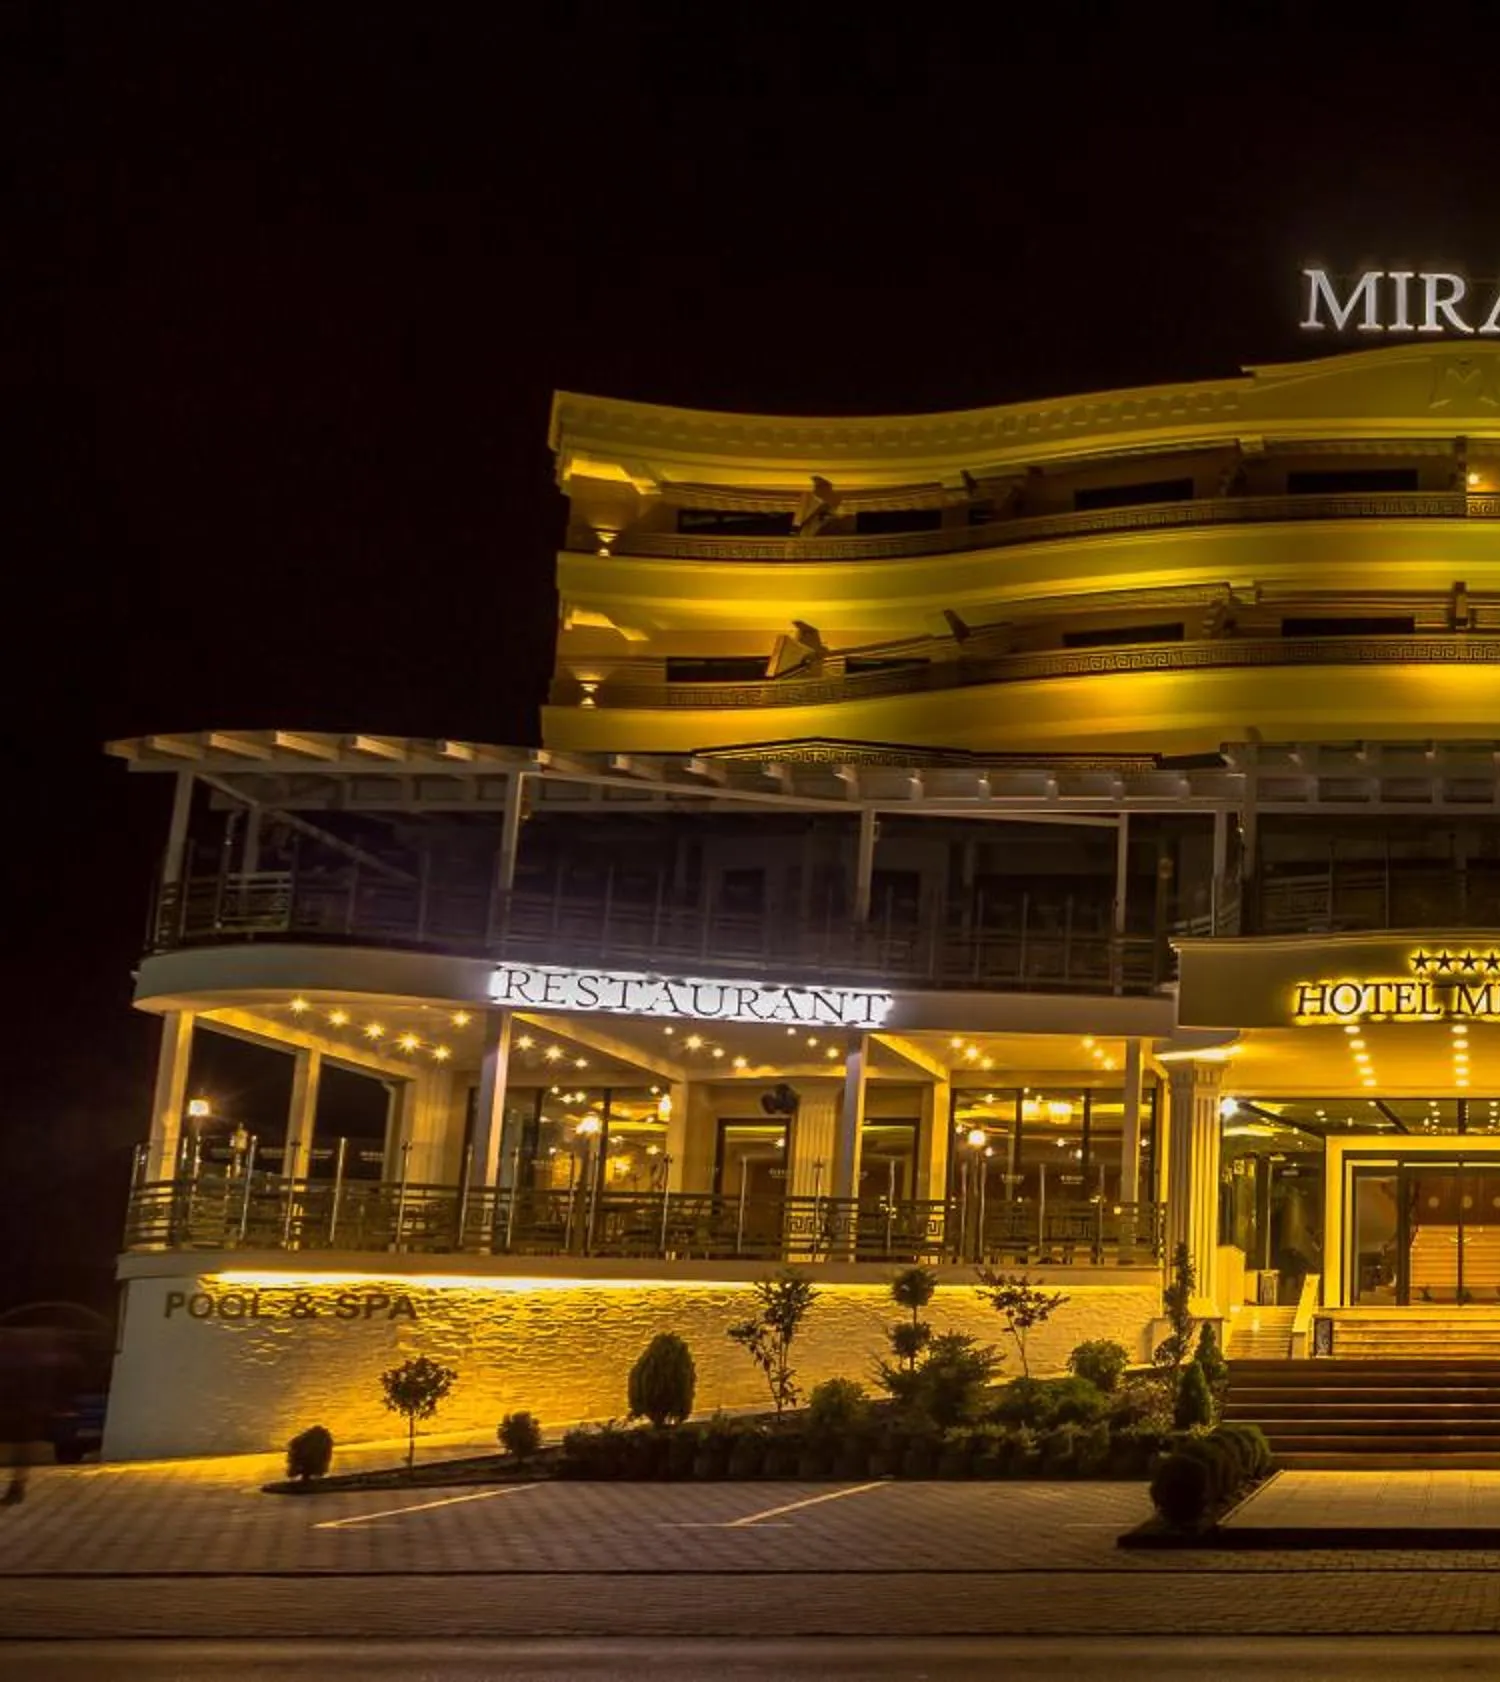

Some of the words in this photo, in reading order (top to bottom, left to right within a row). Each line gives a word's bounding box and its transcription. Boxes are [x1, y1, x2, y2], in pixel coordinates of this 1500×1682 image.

[497, 967, 893, 1026] RESTAURANT
[1296, 982, 1441, 1017] HOTEL
[164, 1291, 273, 1320] POOL
[289, 1292, 317, 1319] &
[334, 1293, 418, 1320] SPA
